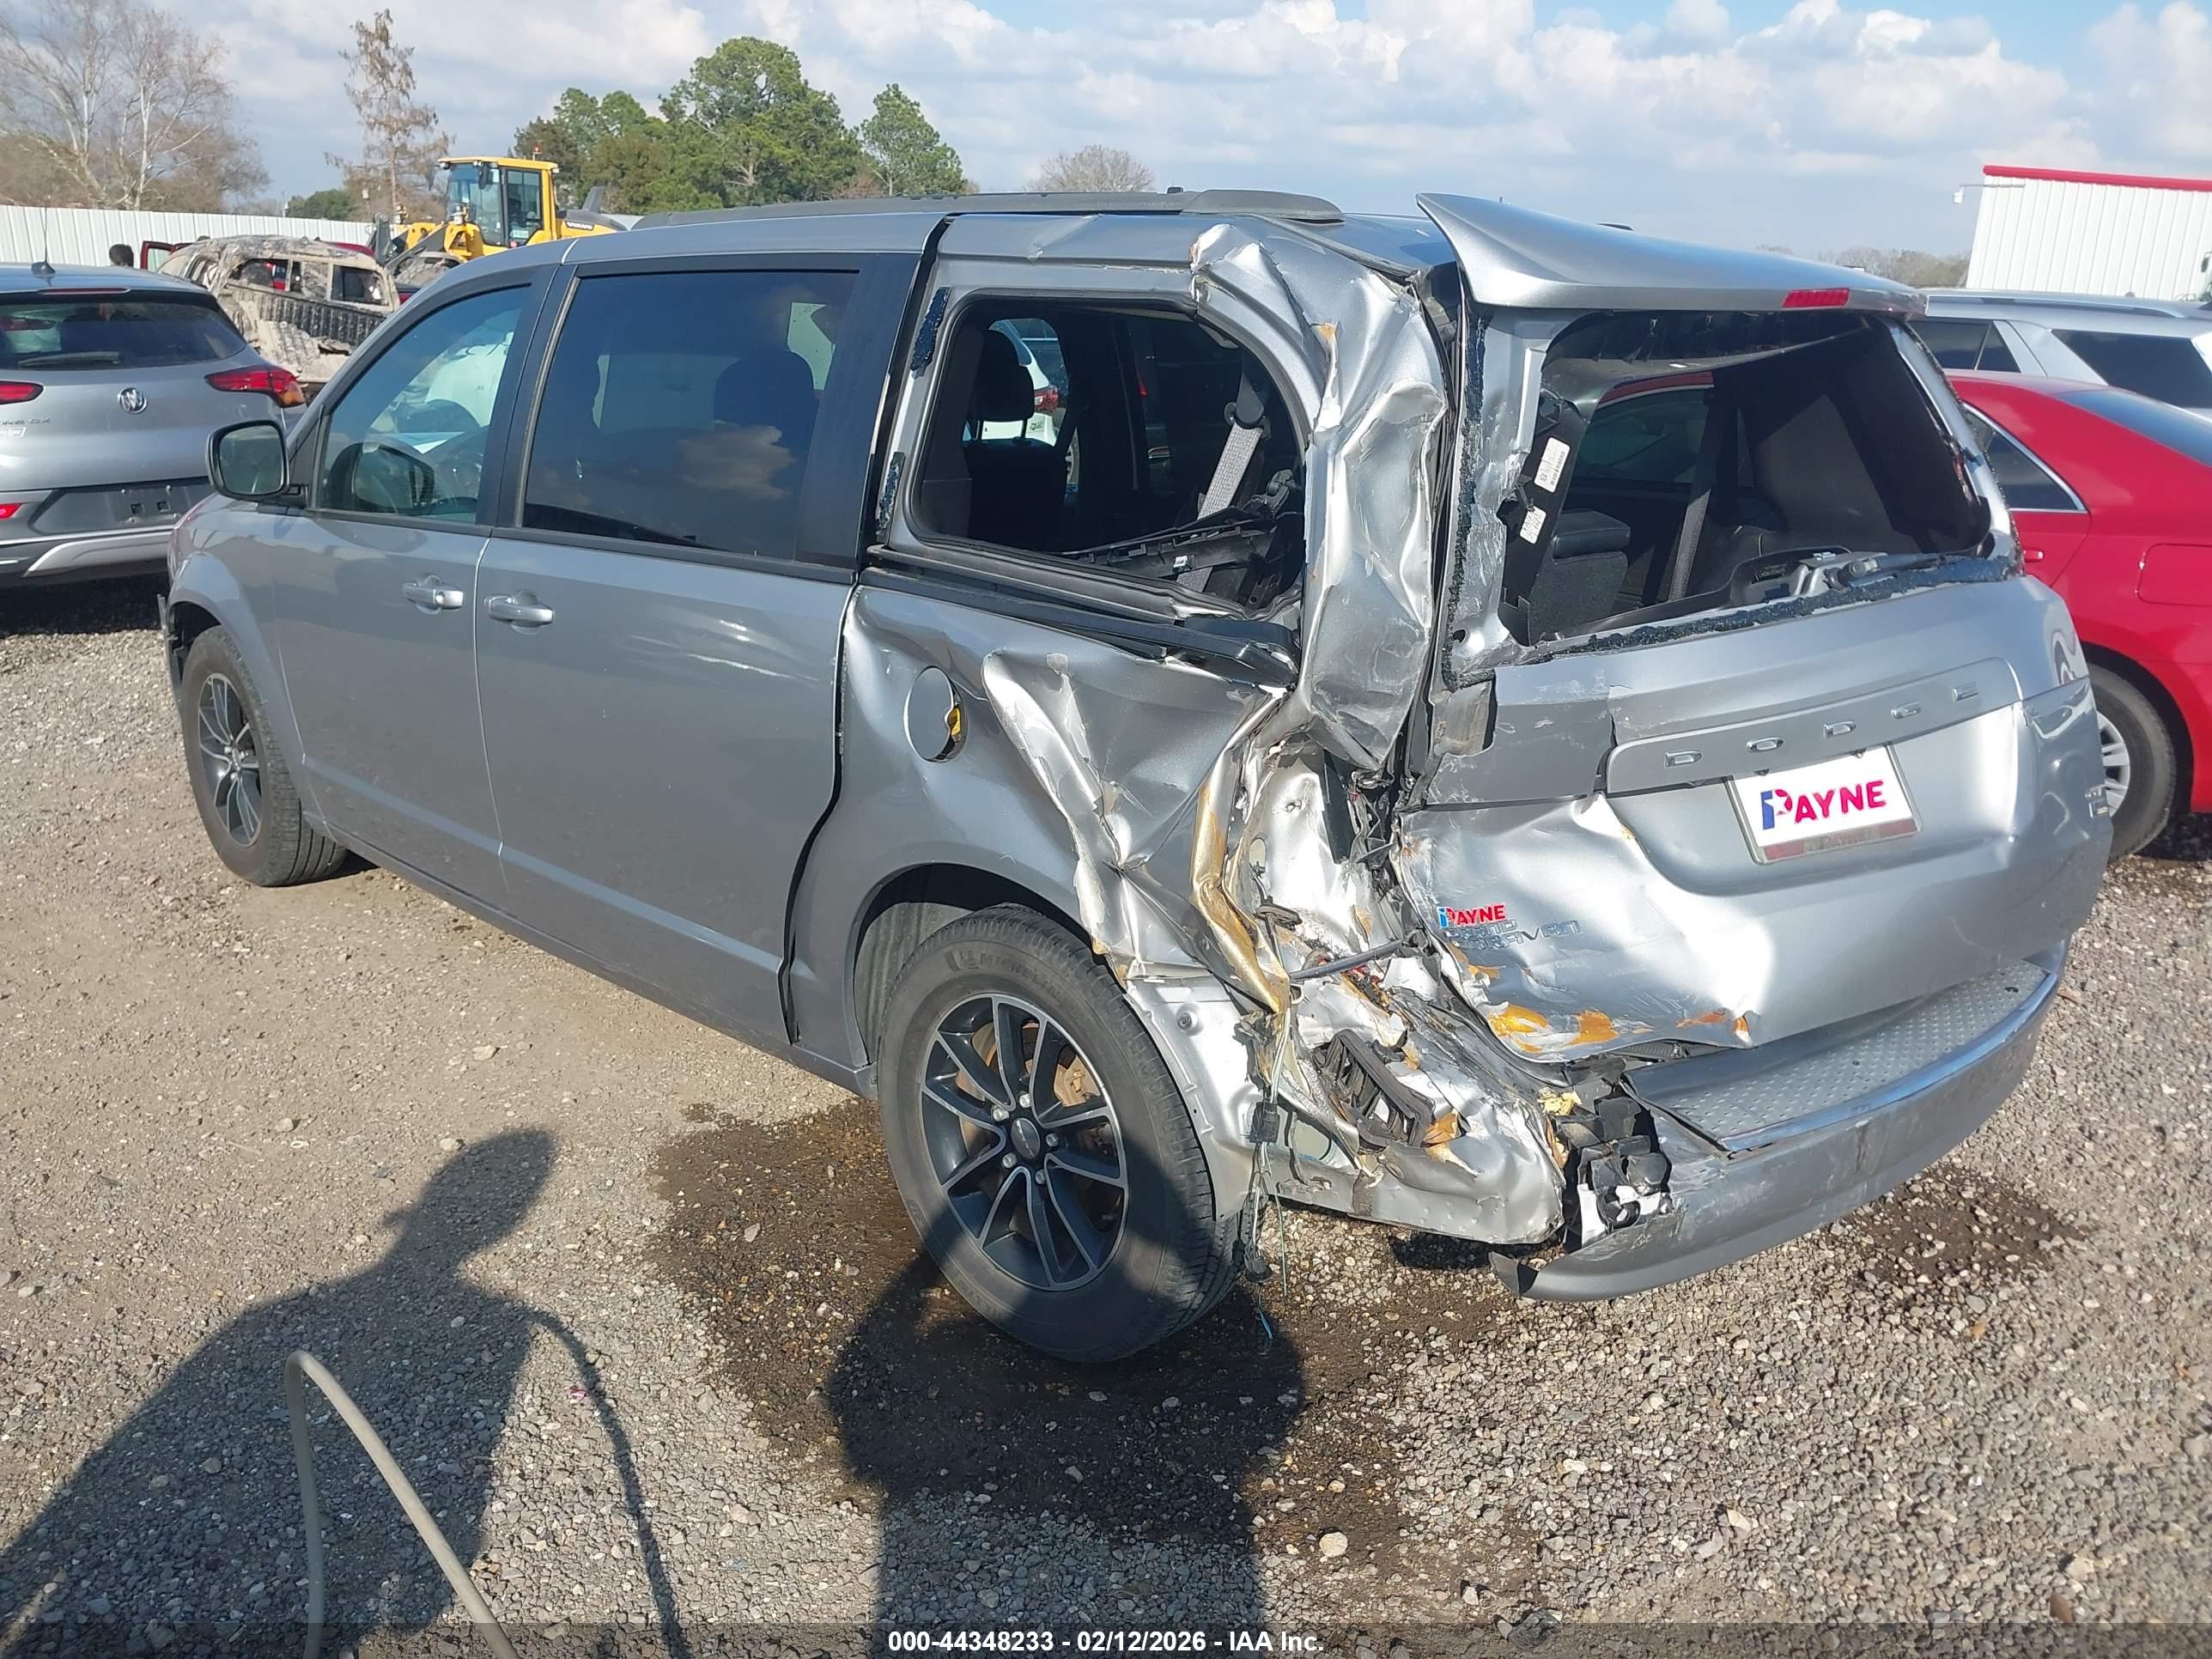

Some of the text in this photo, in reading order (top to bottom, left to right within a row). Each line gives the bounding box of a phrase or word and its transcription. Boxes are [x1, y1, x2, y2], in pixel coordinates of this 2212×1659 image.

[1663, 685, 1979, 768] DODGE
[1760, 780, 1887, 830] PAYNE
[1437, 903, 1507, 928] PAYNE
